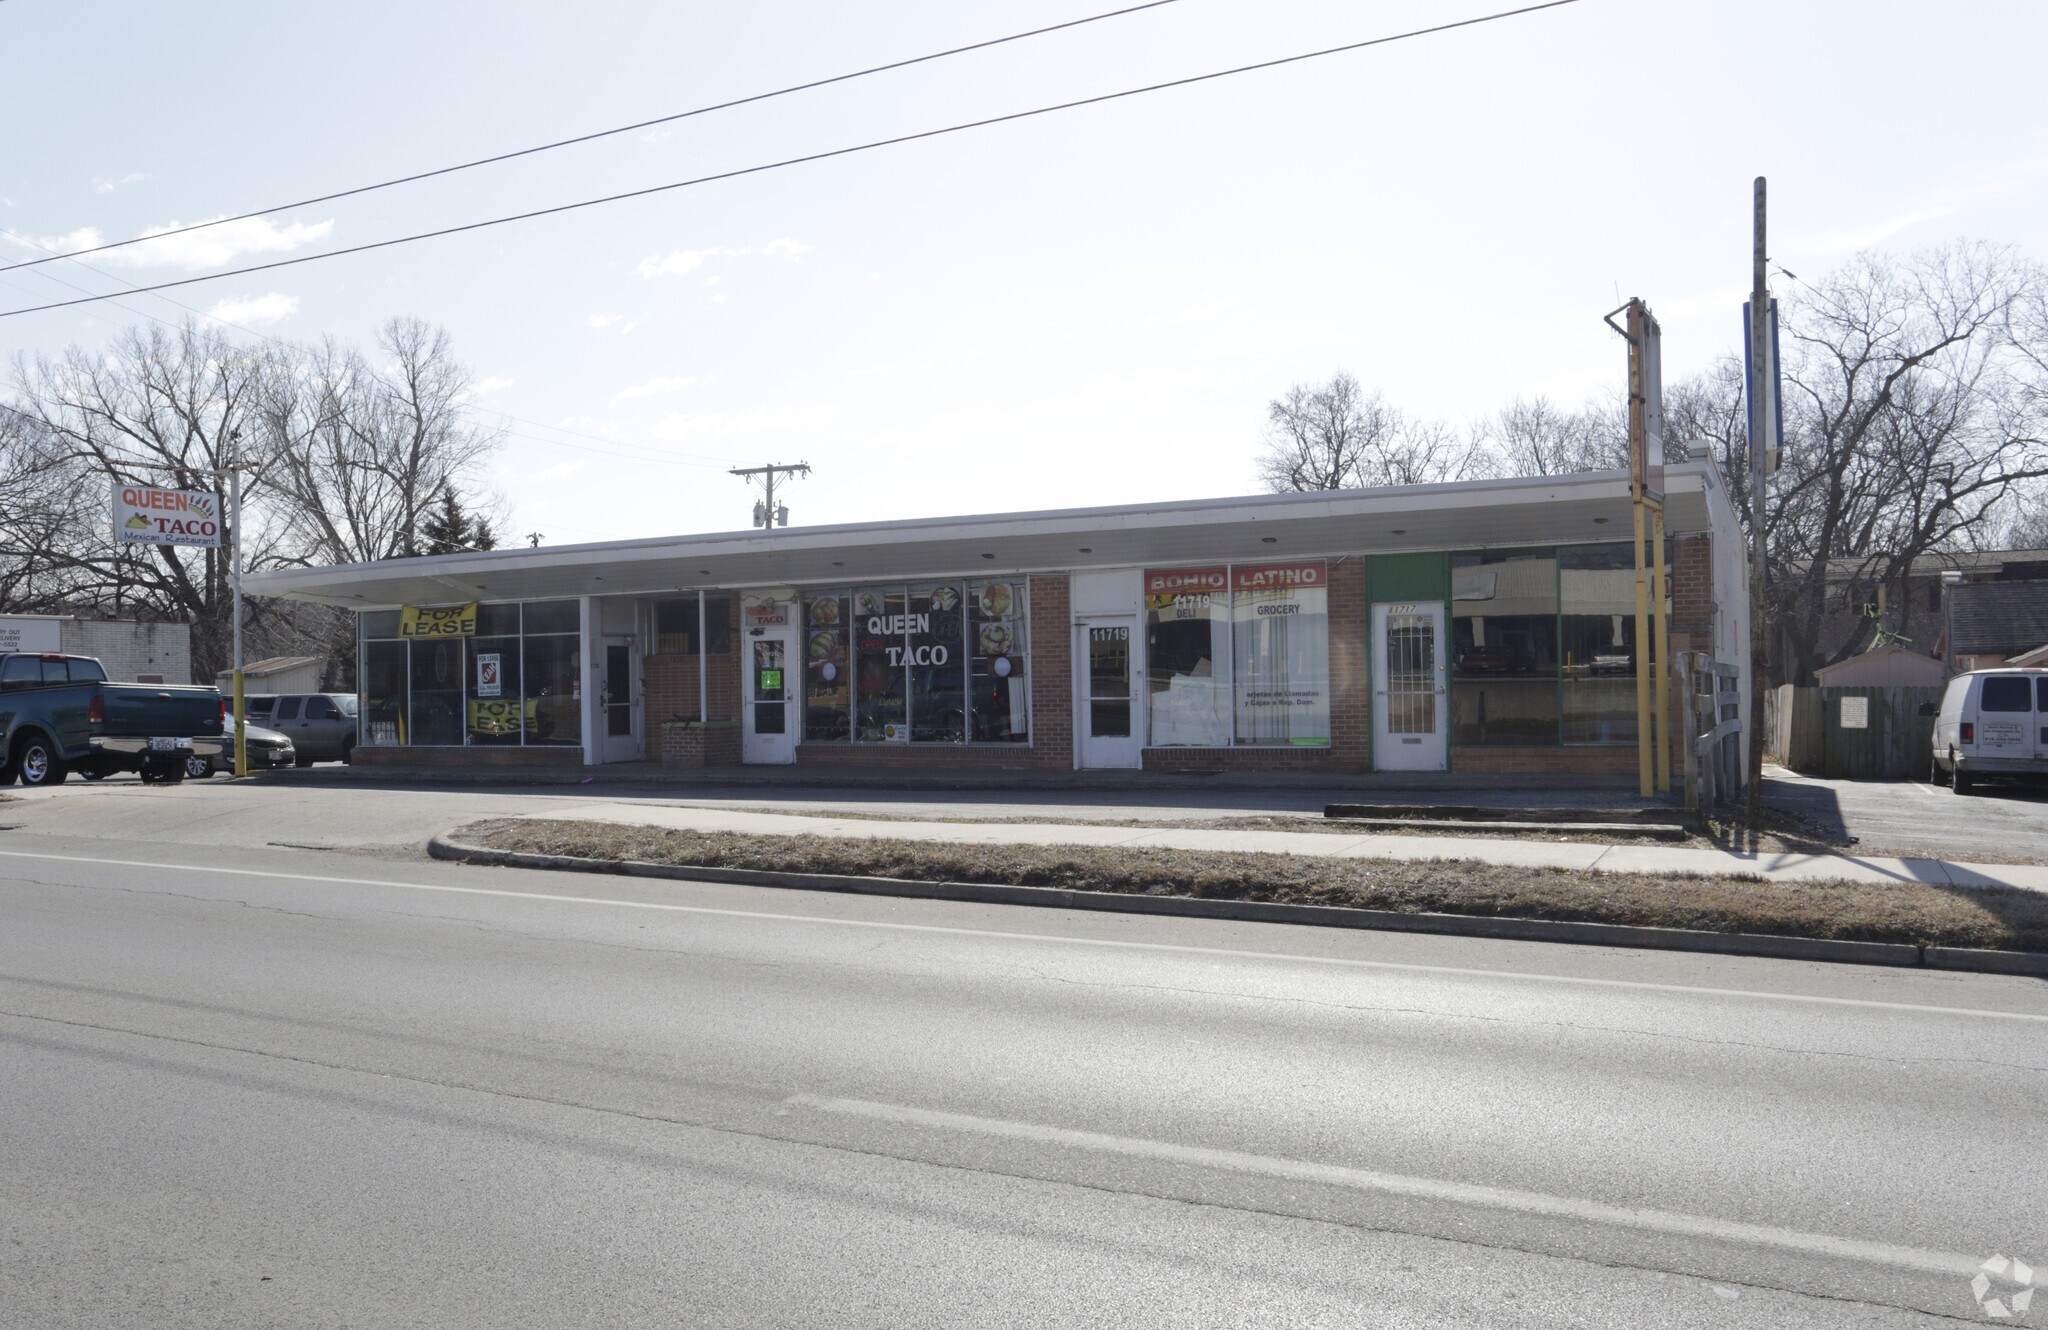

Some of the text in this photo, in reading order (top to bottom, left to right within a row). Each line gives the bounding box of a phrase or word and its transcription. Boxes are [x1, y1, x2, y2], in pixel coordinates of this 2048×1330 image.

[122, 488, 188, 511] QUEEN
[154, 517, 217, 536] TACO
[124, 532, 216, 545] Mexican Restaurant
[1151, 568, 1317, 590] BOHIO LATINO
[1173, 594, 1210, 609] 11719
[417, 606, 465, 620] FOR
[1176, 608, 1196, 618] DELI
[1257, 604, 1300, 615] GROCERY
[1389, 604, 1416, 614] 11717
[402, 618, 474, 635] LEASE
[757, 615, 784, 625] TACO
[868, 613, 929, 635] QUEEN
[1092, 628, 1128, 641] 11719
[885, 645, 948, 667] TACO
